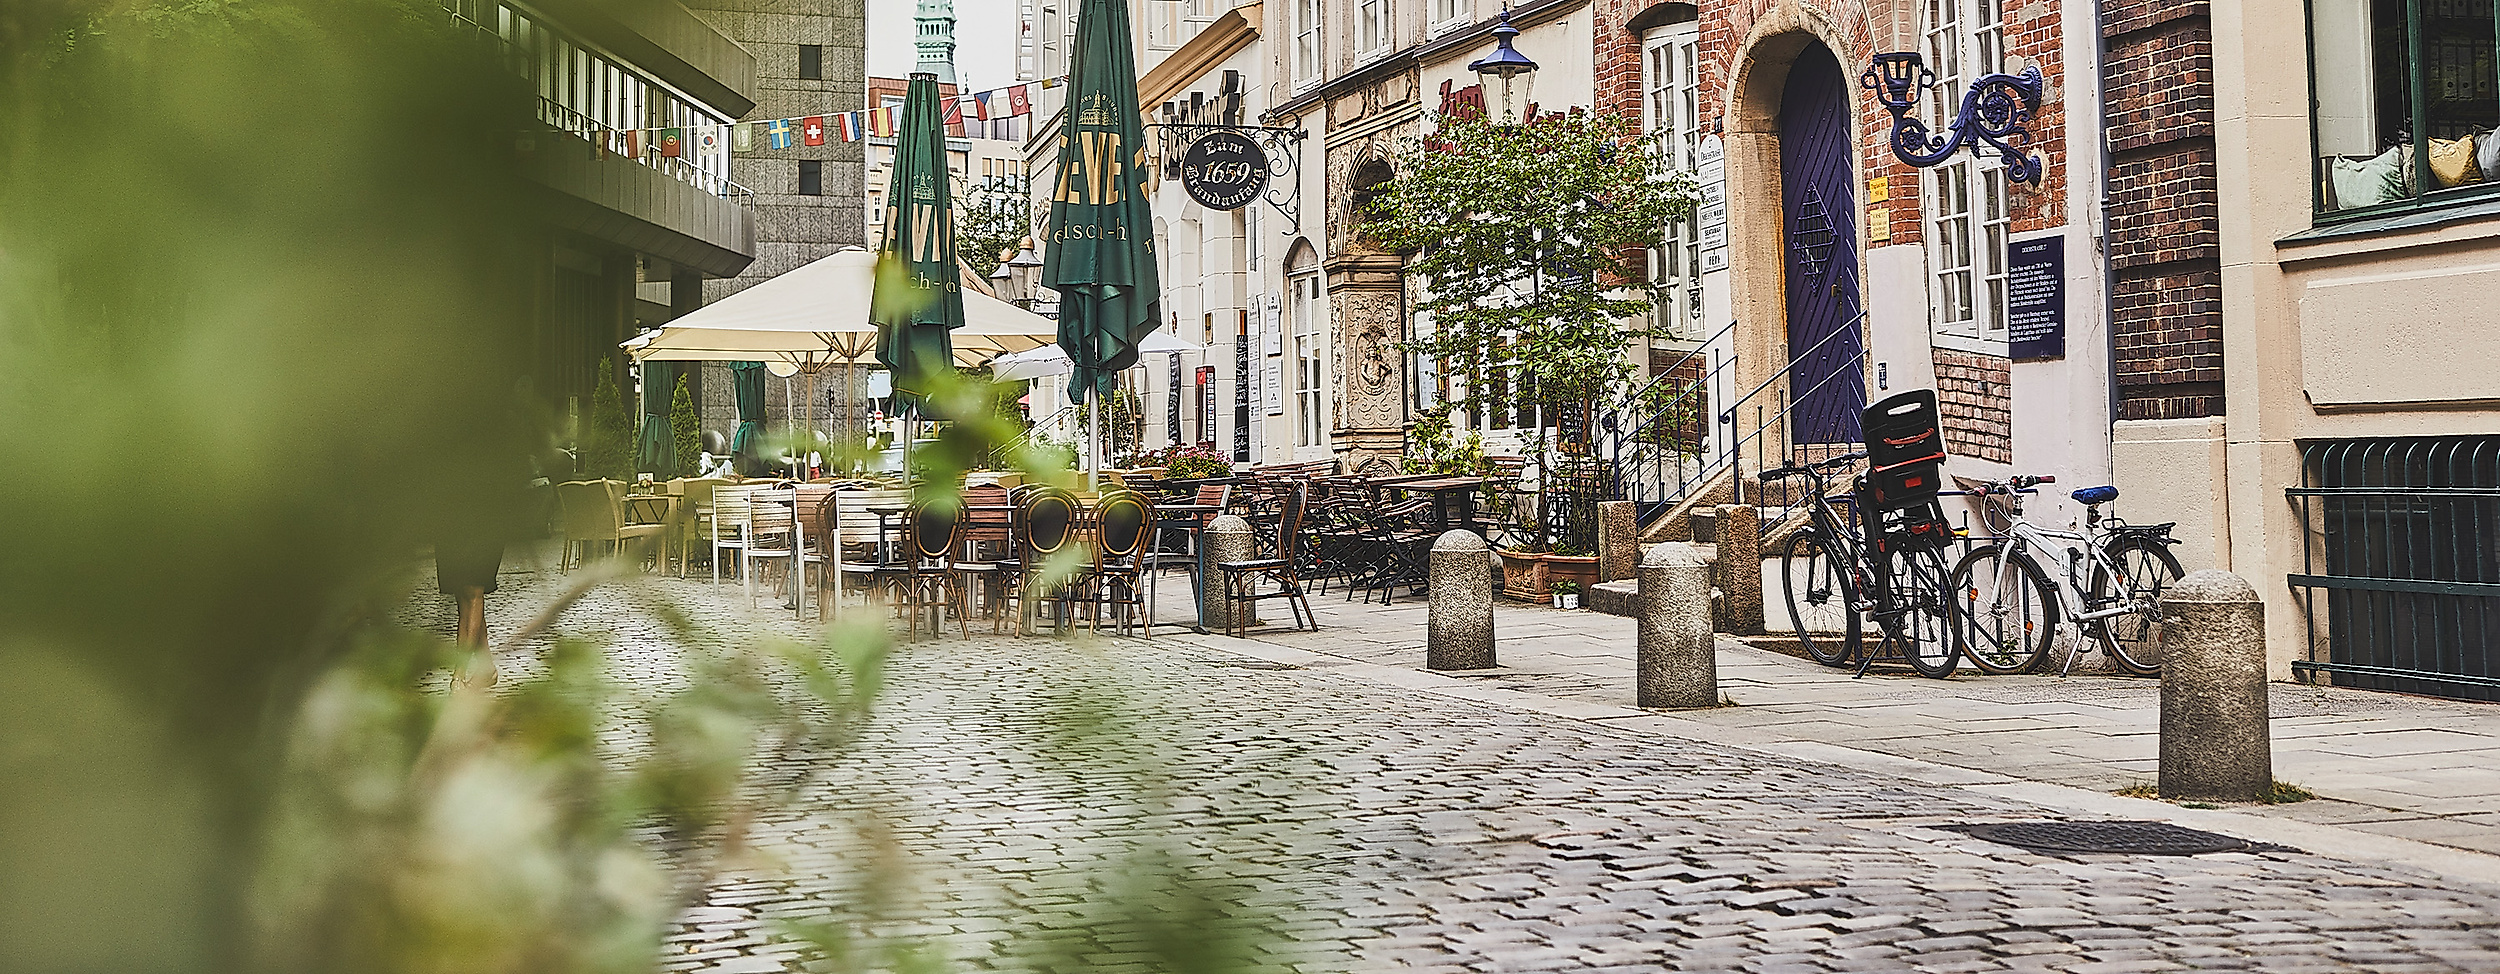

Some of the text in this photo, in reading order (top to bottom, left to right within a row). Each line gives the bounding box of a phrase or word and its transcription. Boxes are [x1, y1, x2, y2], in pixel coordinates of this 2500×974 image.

[1203, 140, 1244, 155] Zum
[1185, 164, 1266, 207] Brandanfang
[1201, 161, 1251, 186] 1659
